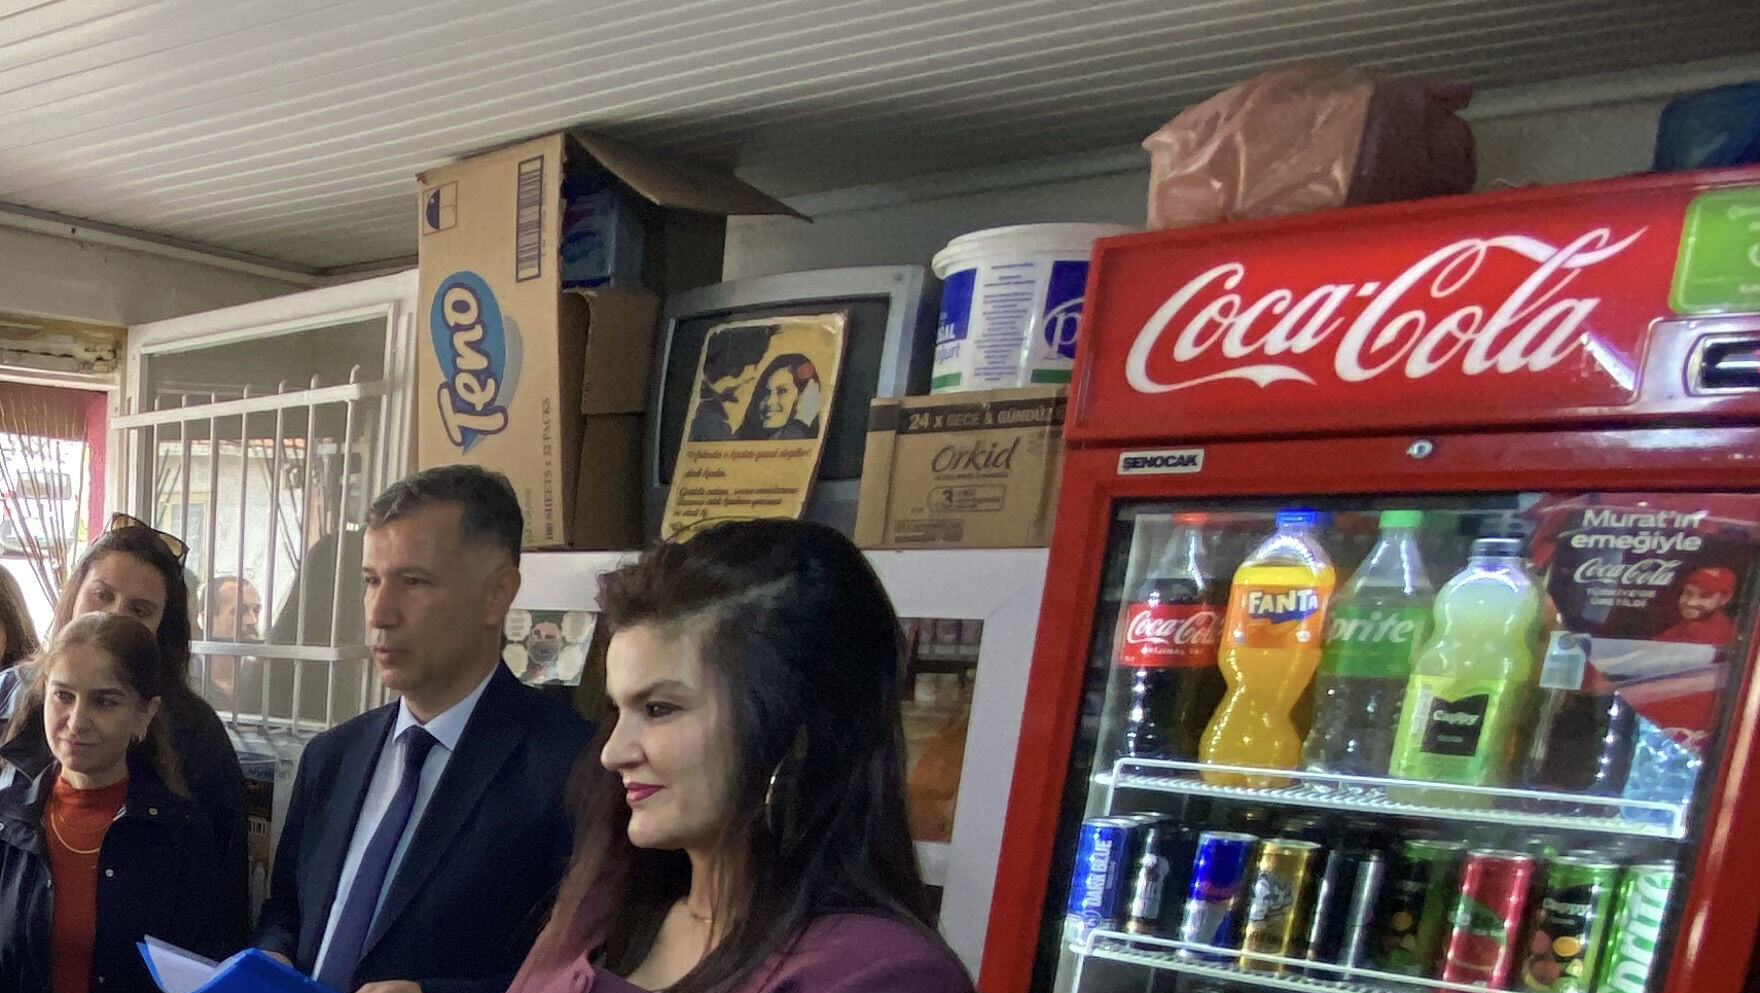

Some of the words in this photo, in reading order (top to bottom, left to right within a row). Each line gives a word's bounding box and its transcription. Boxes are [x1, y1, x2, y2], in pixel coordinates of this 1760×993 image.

[1124, 225, 1648, 394] Coca-Cola
[438, 280, 510, 448] Teno
[541, 398, 552, 441] PACKS
[909, 413, 928, 431] 24
[931, 436, 1020, 473] Orkid
[543, 470, 553, 520] SHEETS
[1570, 531, 1703, 554] emeğiyle
[1247, 591, 1320, 615] FANTA
[1328, 614, 1415, 645] prite
[1093, 838, 1114, 870] BLUE
[1091, 871, 1108, 908] DARK
